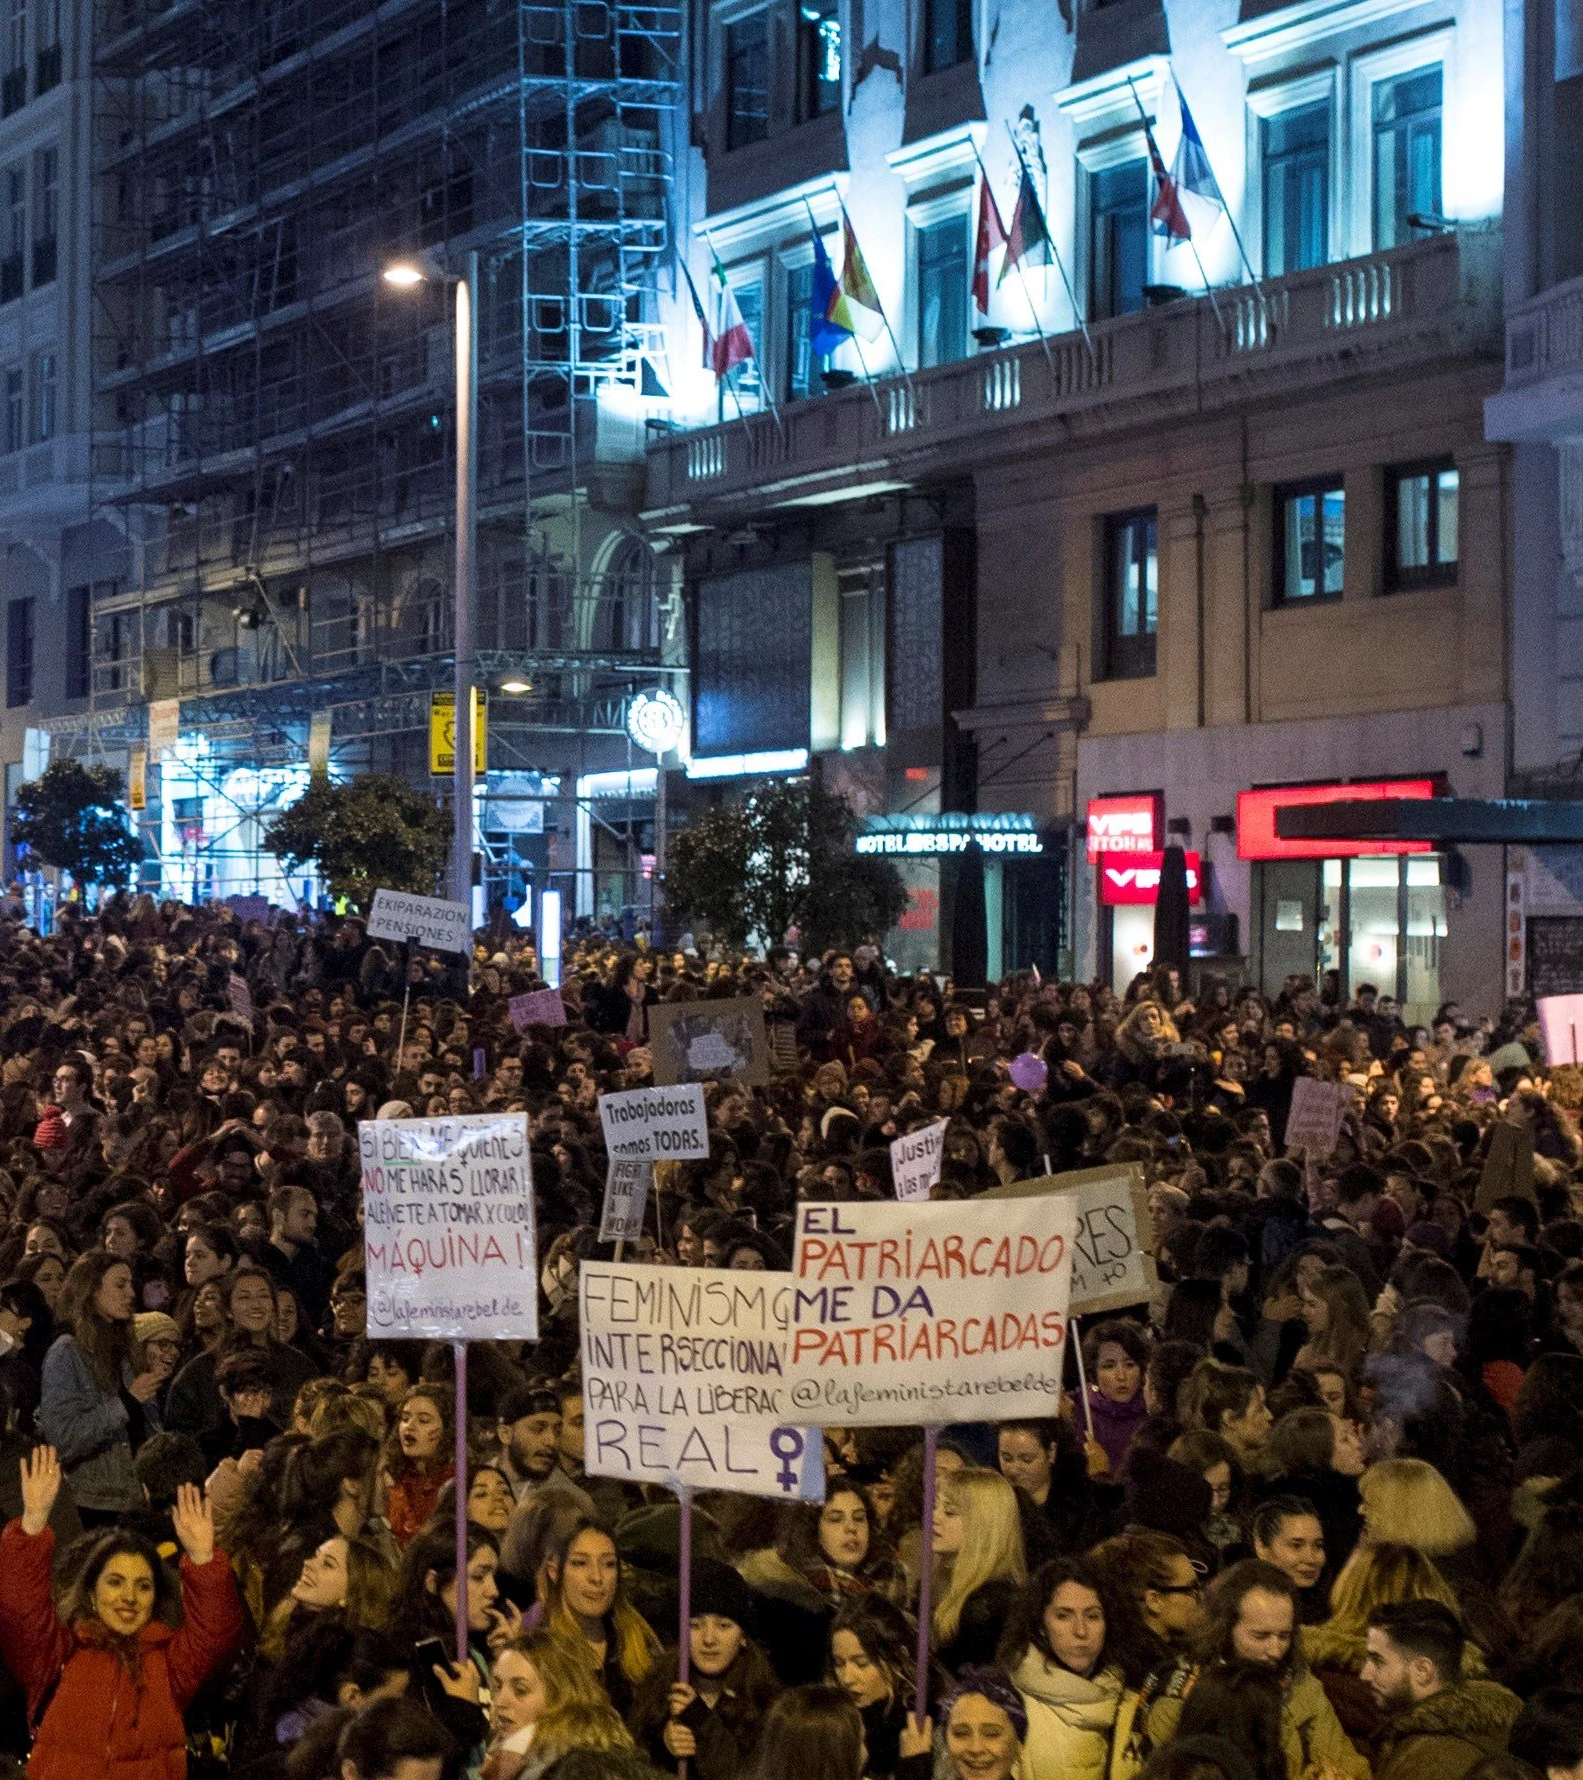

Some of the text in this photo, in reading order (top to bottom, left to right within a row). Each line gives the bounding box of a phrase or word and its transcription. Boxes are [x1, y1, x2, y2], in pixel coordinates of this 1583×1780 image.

[376, 917, 454, 942] PENSIONES
[605, 1096, 696, 1125] Trabajadoras
[652, 1129, 704, 1152] TODAS.
[363, 1167, 385, 1194] NO
[387, 1168, 406, 1193] ME
[803, 1207, 856, 1235] EL
[799, 1228, 1065, 1281] PATRIARCADO
[793, 1285, 934, 1324] ME DA
[792, 1311, 1065, 1367] PATRIARCADAS
[588, 1377, 650, 1415] PARA
[659, 1386, 689, 1416] LA
[791, 1372, 1057, 1414] @lafeministarebelde
[596, 1419, 759, 1476] REAL
